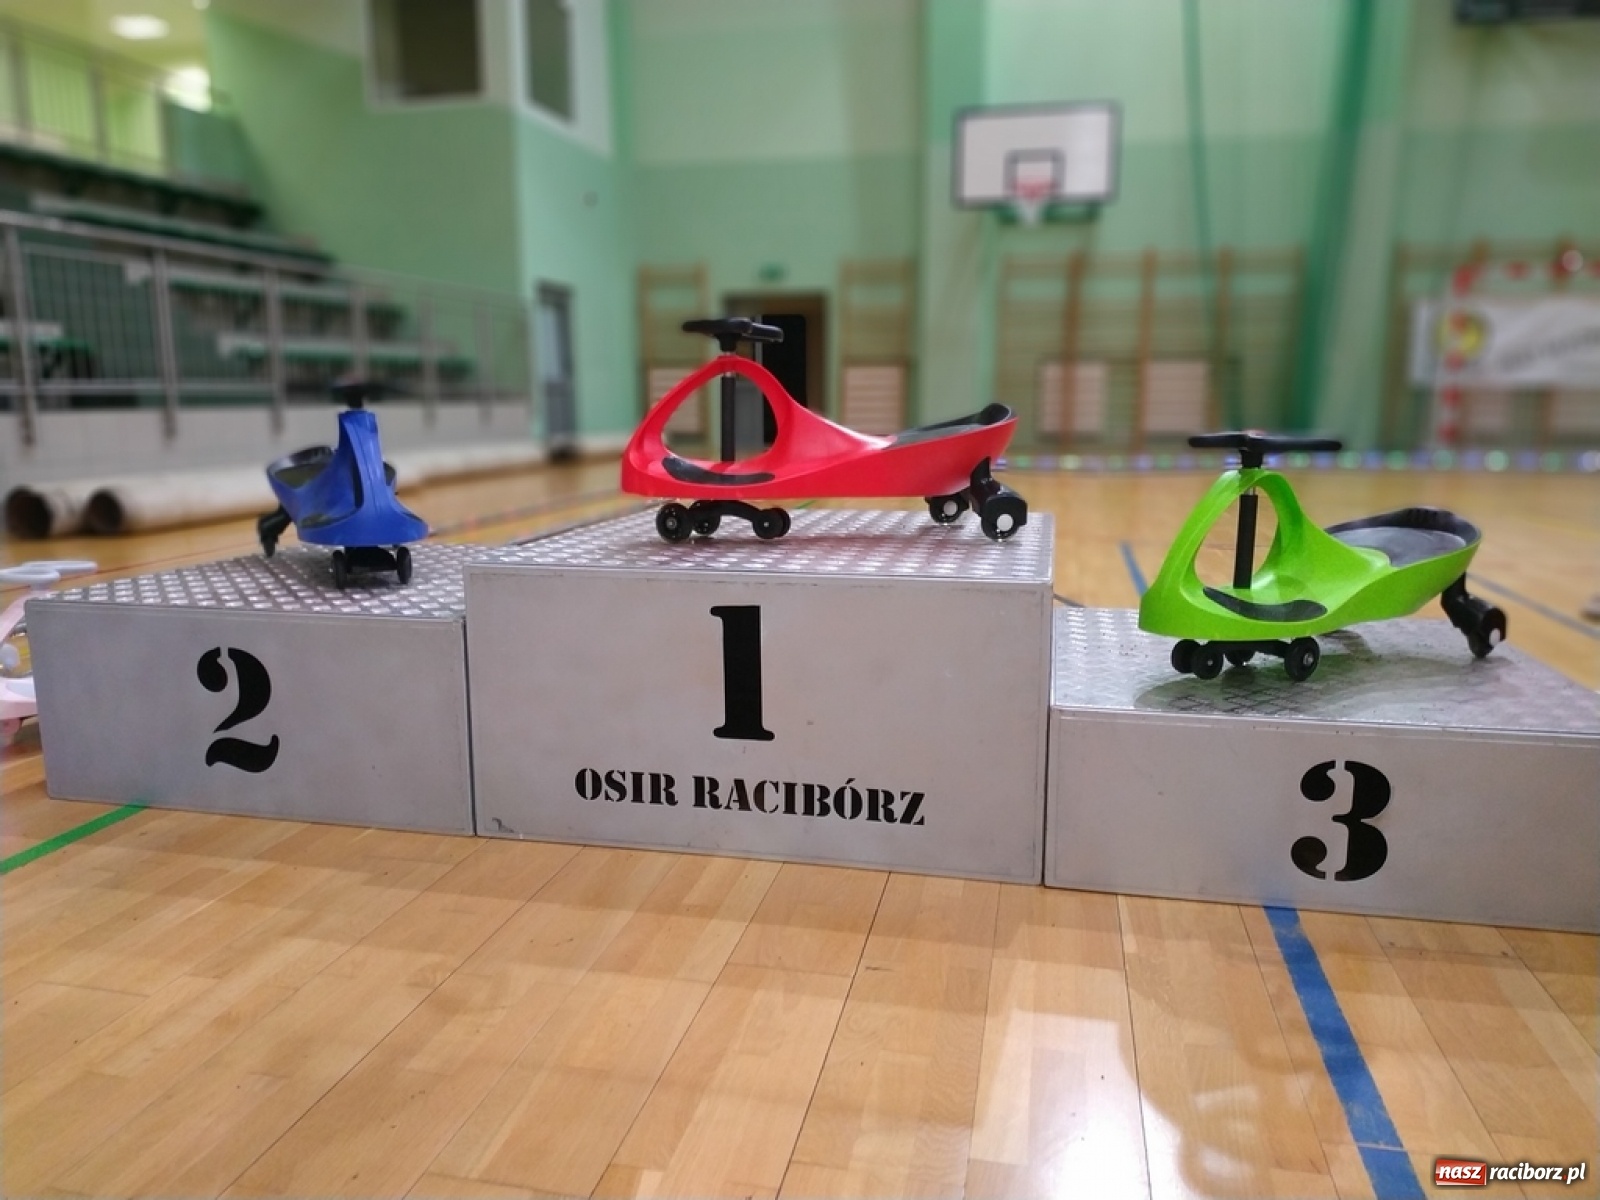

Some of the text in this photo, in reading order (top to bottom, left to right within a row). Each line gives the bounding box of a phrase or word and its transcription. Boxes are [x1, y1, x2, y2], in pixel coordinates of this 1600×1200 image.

[196, 646, 281, 774] 2
[709, 604, 776, 742] 1
[574, 767, 927, 827] OSIR RACIBÓRZ
[1290, 759, 1392, 882] 3
